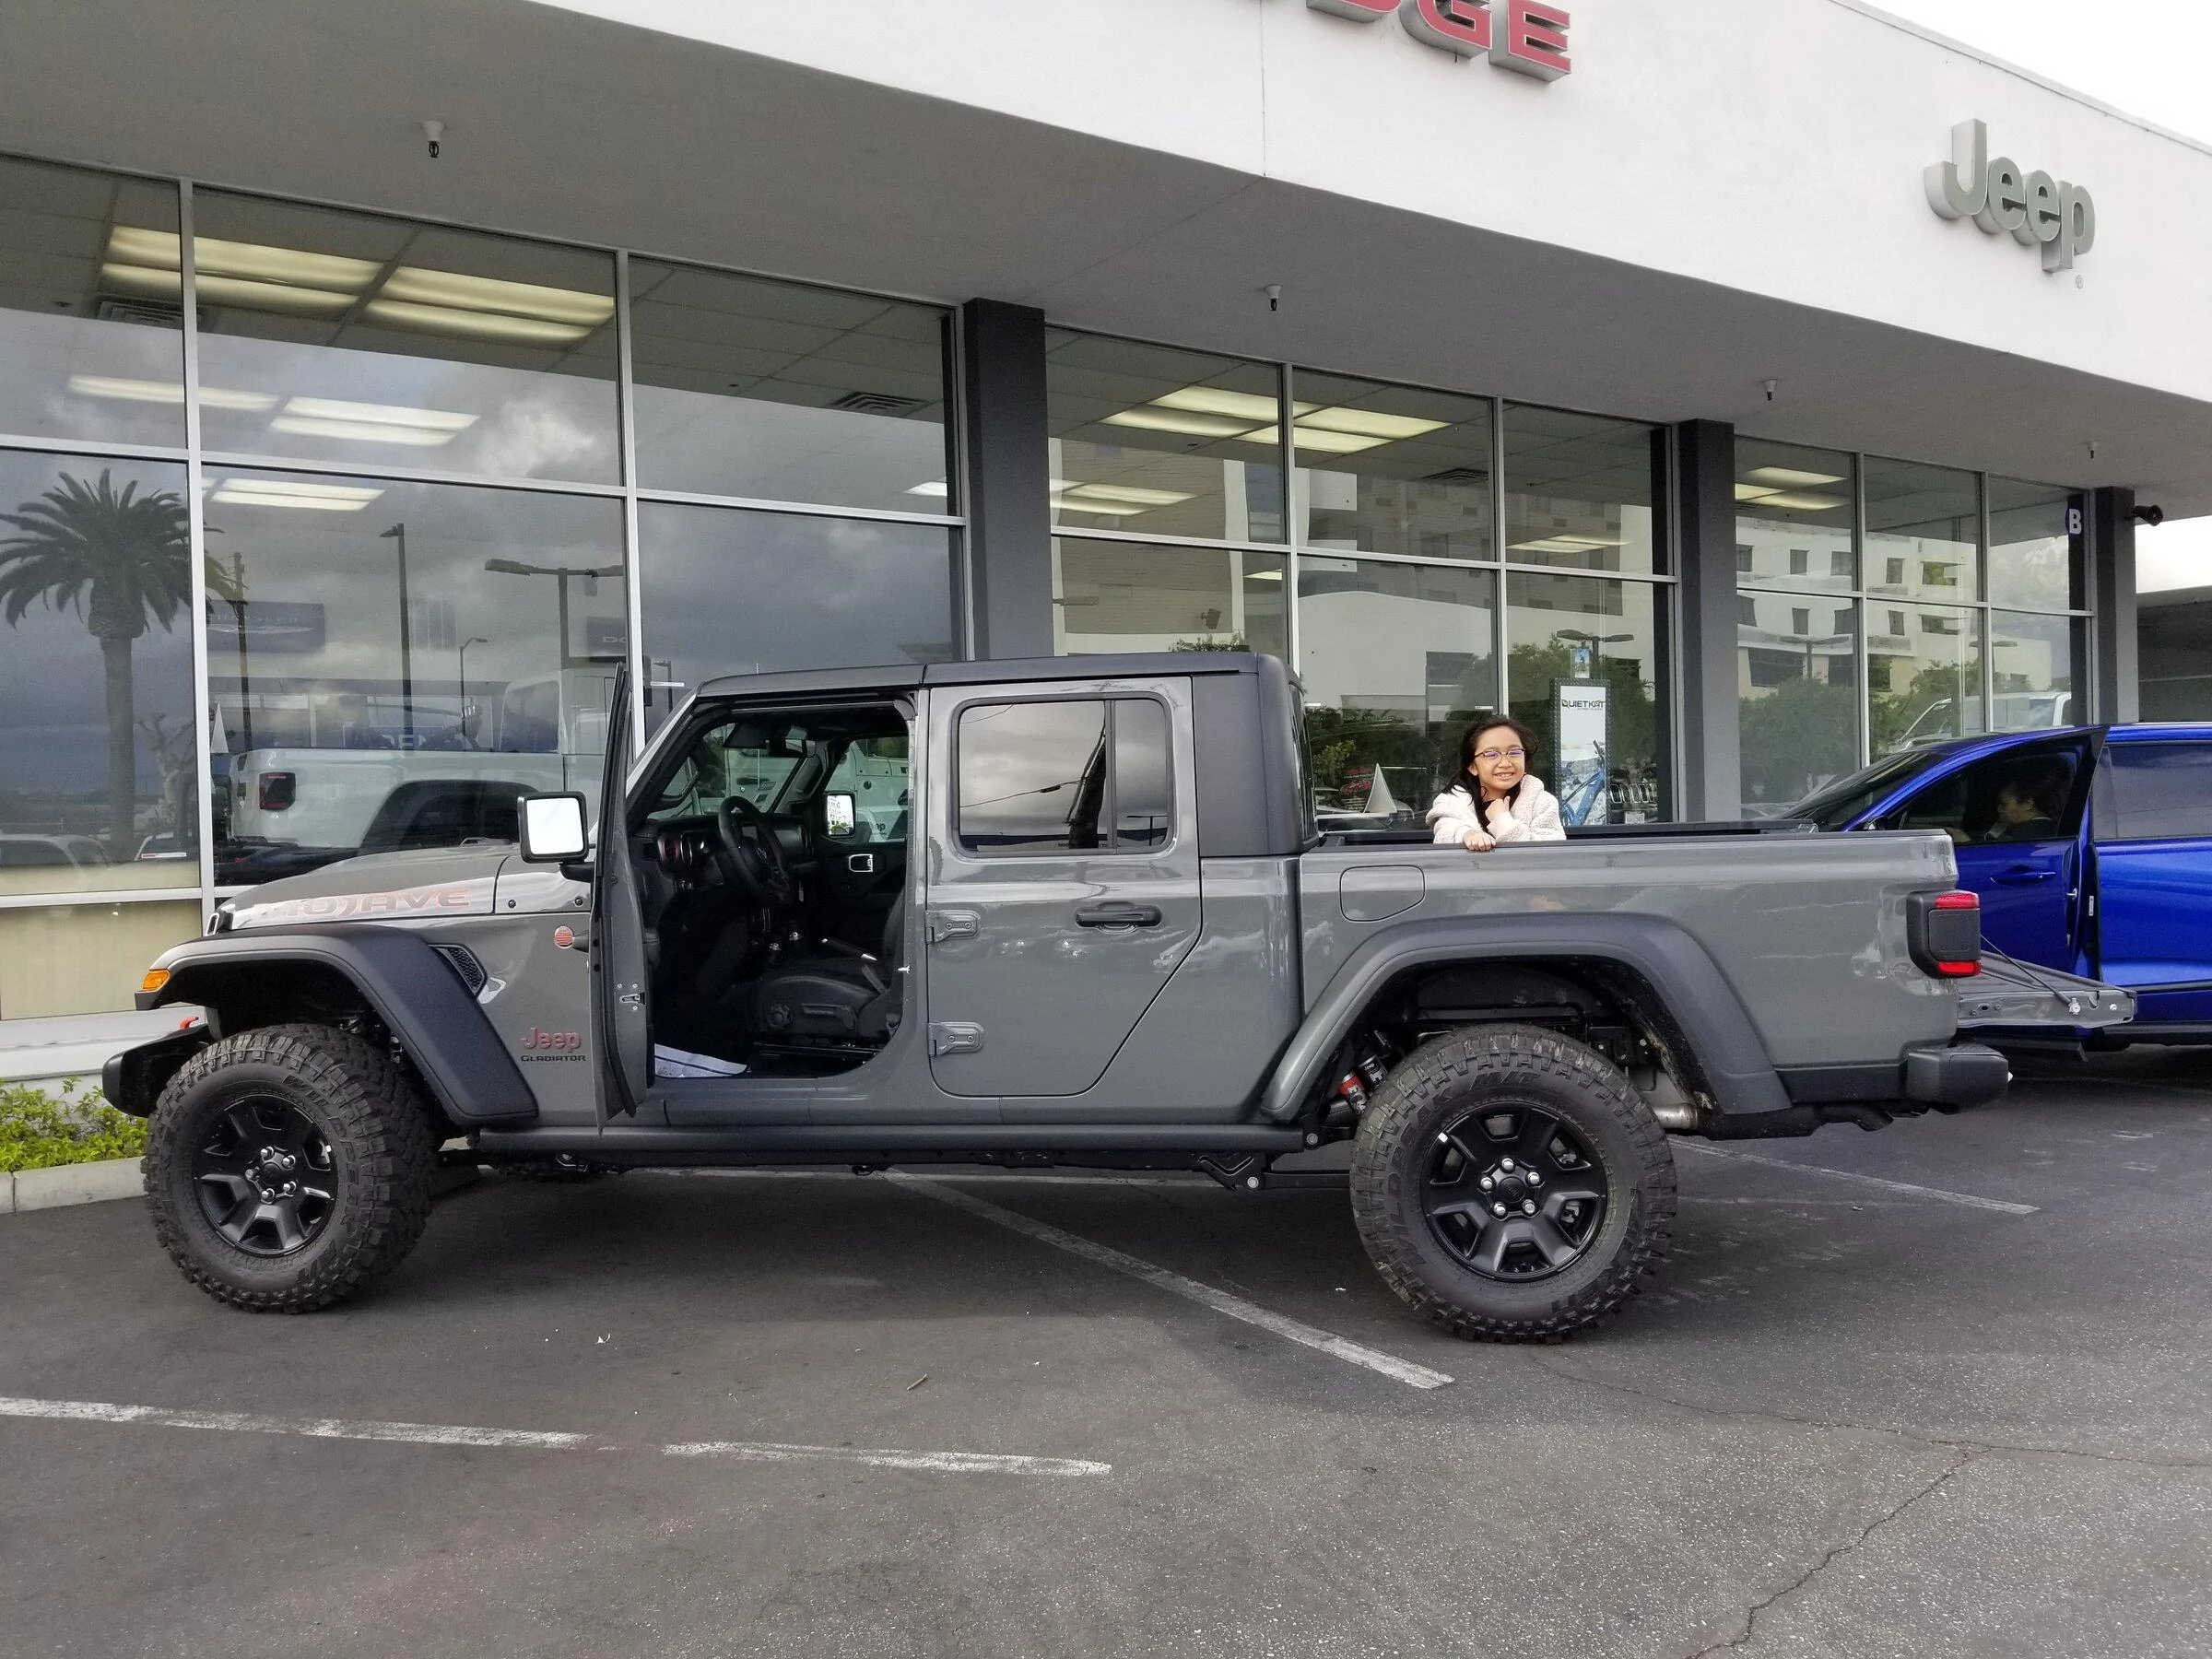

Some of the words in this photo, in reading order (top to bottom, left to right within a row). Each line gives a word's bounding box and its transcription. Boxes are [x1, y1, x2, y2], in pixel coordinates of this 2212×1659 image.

[1925, 119, 2095, 273] Jeep
[2068, 508, 2082, 535] B
[521, 1025, 582, 1053] Jeep
